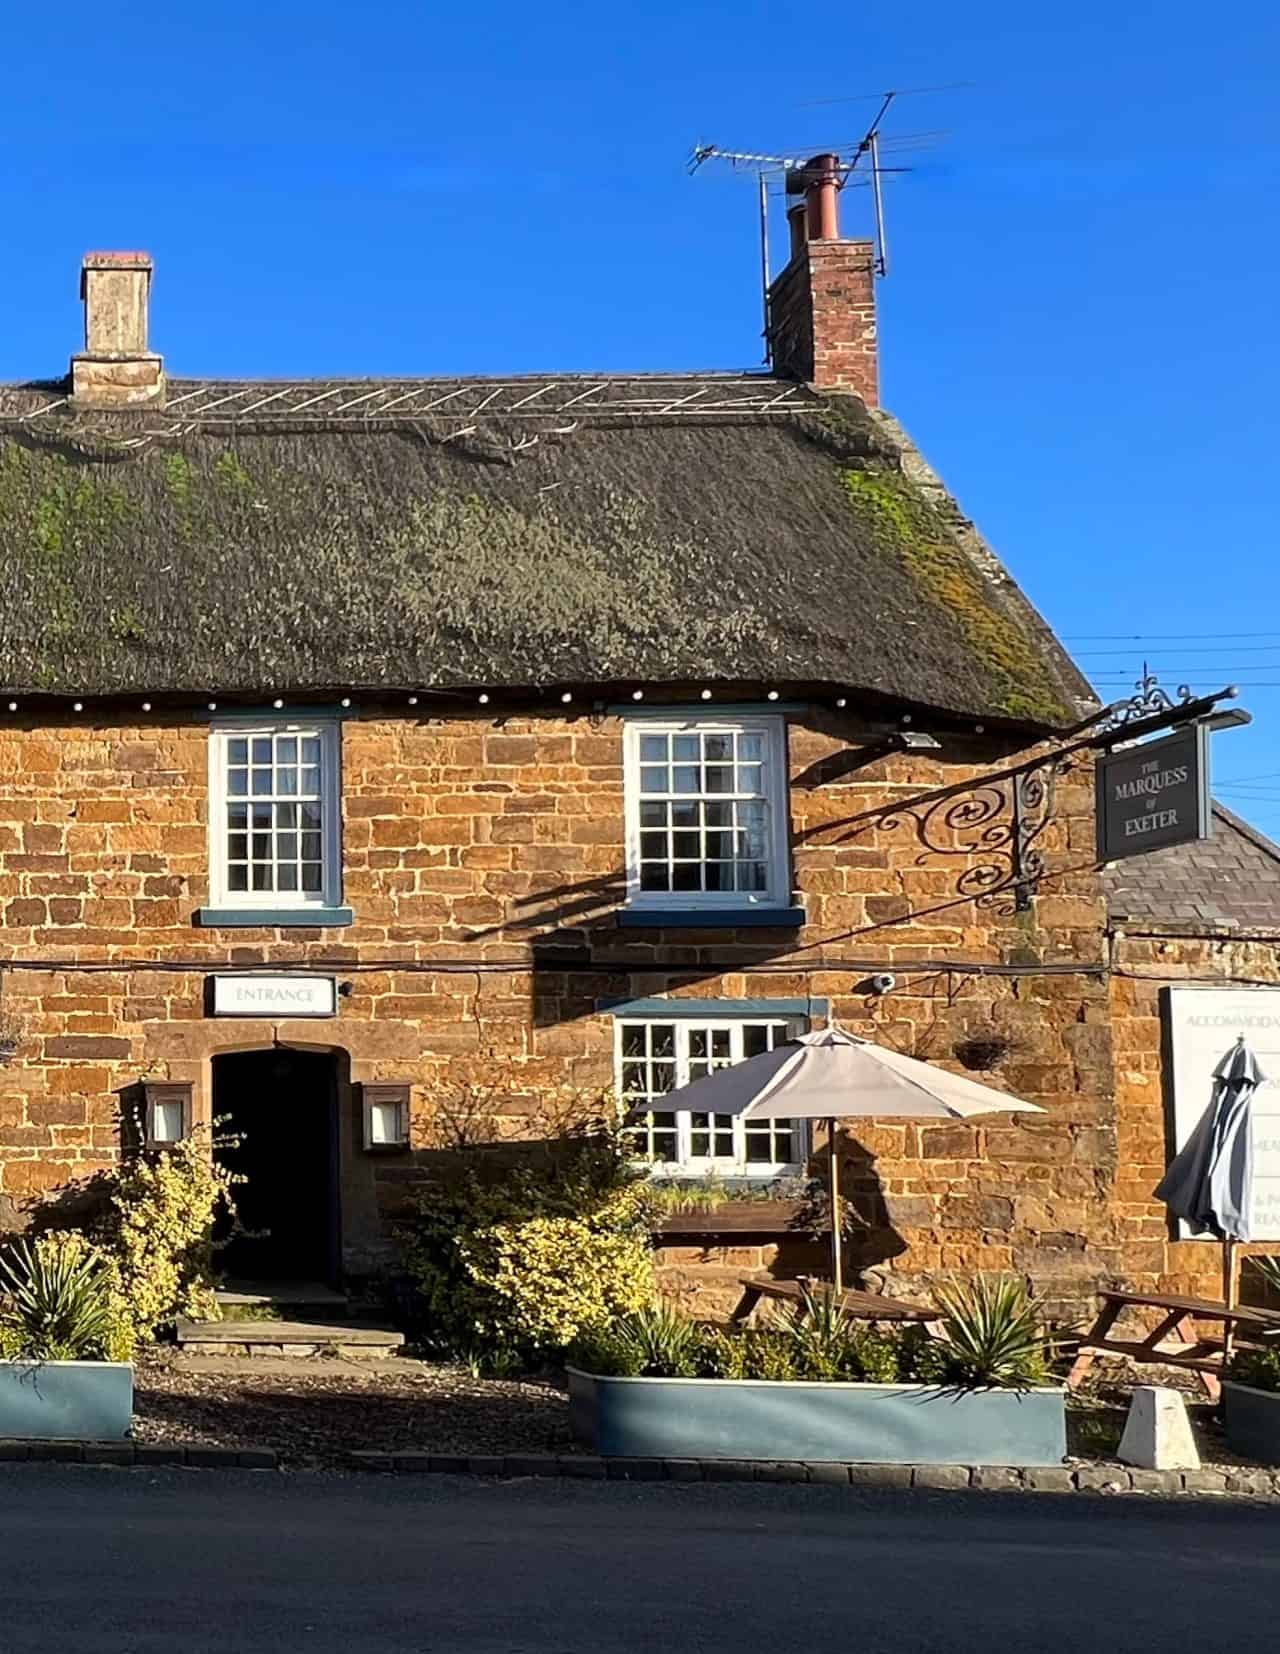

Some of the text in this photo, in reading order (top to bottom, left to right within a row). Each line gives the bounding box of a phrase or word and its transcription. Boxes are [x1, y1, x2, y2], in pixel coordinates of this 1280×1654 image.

[1141, 761, 1159, 773] THE
[1115, 766, 1188, 800] MARQUESS
[1145, 798, 1157, 809] OF
[1124, 809, 1178, 836] EXETER
[236, 988, 313, 1002] ENTRANCE
